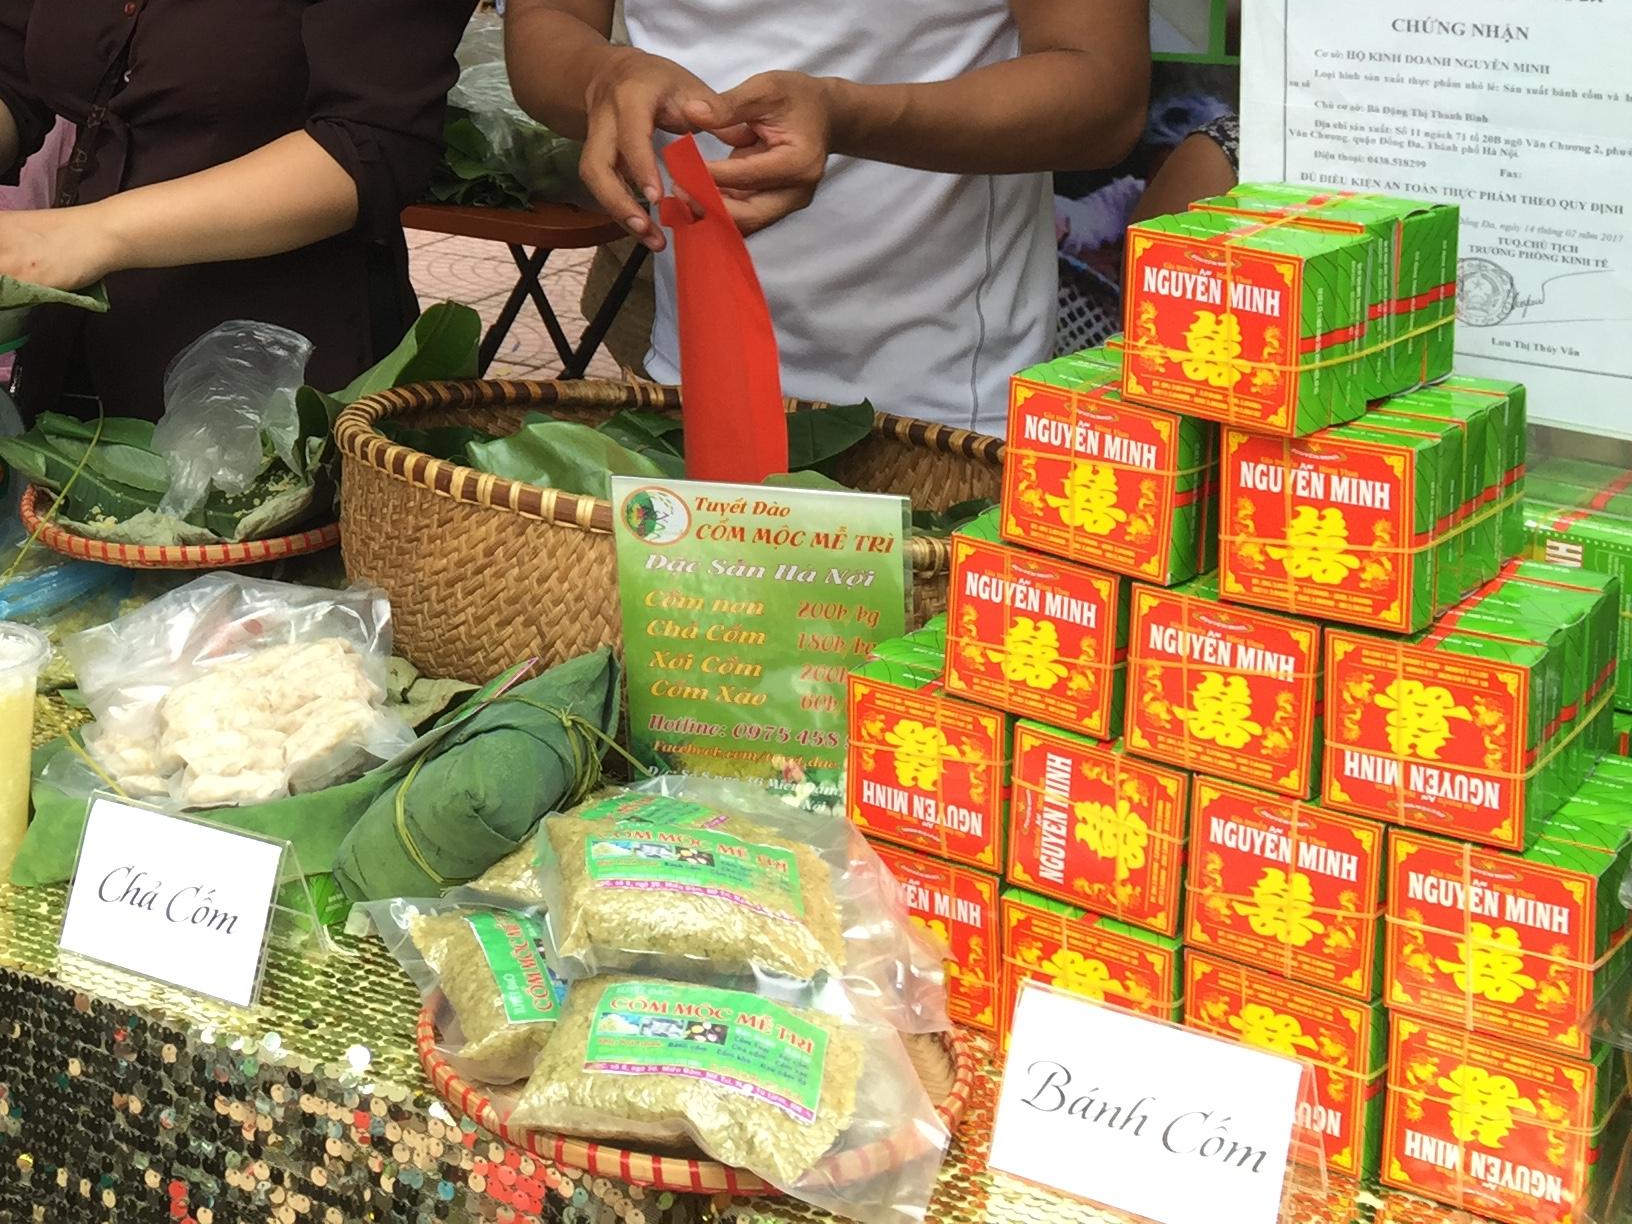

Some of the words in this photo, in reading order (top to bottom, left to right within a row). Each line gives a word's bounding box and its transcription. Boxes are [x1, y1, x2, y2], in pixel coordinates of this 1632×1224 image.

[1392, 16, 1466, 36] CHỨNG
[1471, 22, 1530, 42] NHẬN
[1229, 281, 1281, 317] MINH
[1104, 431, 1157, 470] MINH
[694, 496, 747, 516] Tuyết
[752, 500, 791, 517] Đào
[1329, 474, 1391, 510] MINH
[696, 518, 745, 543] CỐM
[752, 525, 805, 552] MỘC
[810, 526, 847, 550] MỄ
[855, 532, 895, 554] TRÌ
[856, 605, 880, 628] kg
[1044, 589, 1097, 629] MINH
[1236, 646, 1296, 683] MINH
[647, 714, 727, 737] Hotline:
[732, 722, 790, 745] 0975
[795, 729, 840, 747] 458
[1044, 752, 1073, 807] MINH
[1344, 750, 1402, 791] MINH
[862, 780, 909, 813] MINH
[1298, 841, 1358, 882] MINH
[98, 865, 162, 910] Chả
[166, 885, 238, 934] Cốm
[1505, 894, 1570, 935] MINH
[1020, 1060, 1157, 1137] Bánh
[1161, 1110, 1267, 1174] Cốm
[1404, 1128, 1467, 1170] MINH
